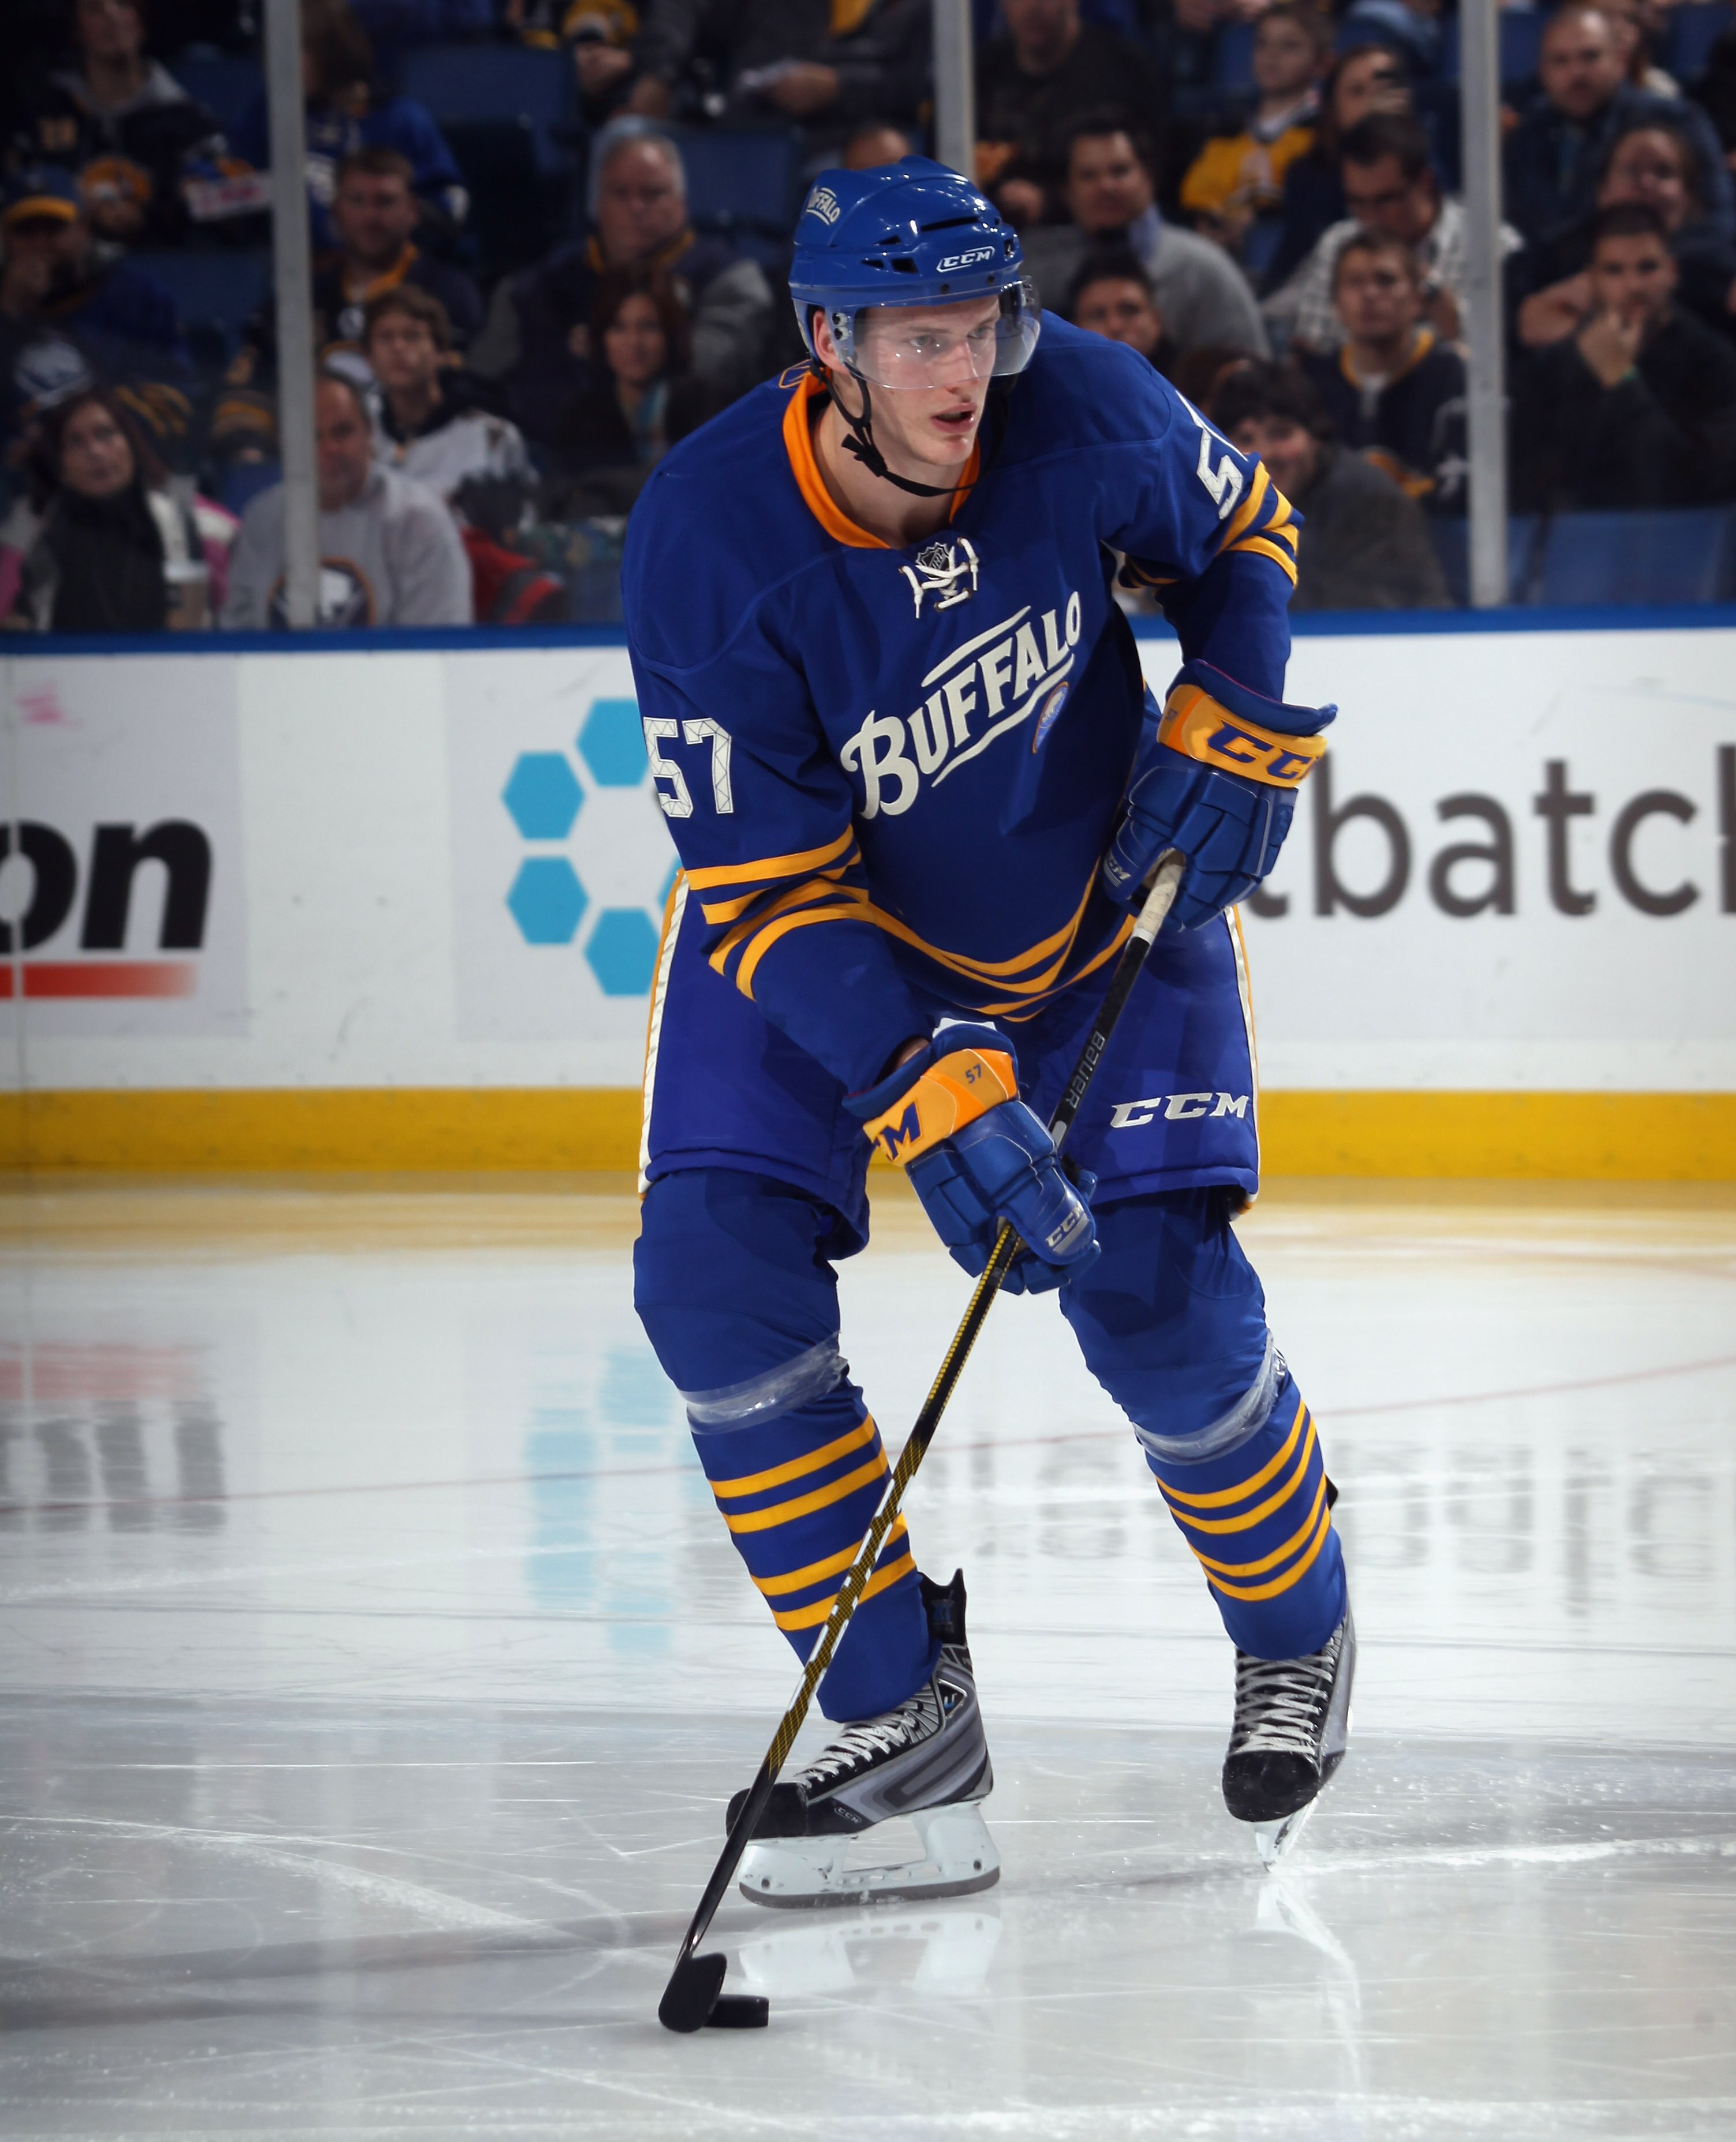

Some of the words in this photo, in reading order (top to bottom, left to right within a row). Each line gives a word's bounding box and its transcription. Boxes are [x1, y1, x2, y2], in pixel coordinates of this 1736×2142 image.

[942, 250, 991, 268] CCM
[840, 591, 1081, 819] BUFFALO
[643, 716, 734, 819] 57
[0, 817, 215, 957] on
[965, 1063, 982, 1084] 57
[1110, 1092, 1249, 1129] CCM
